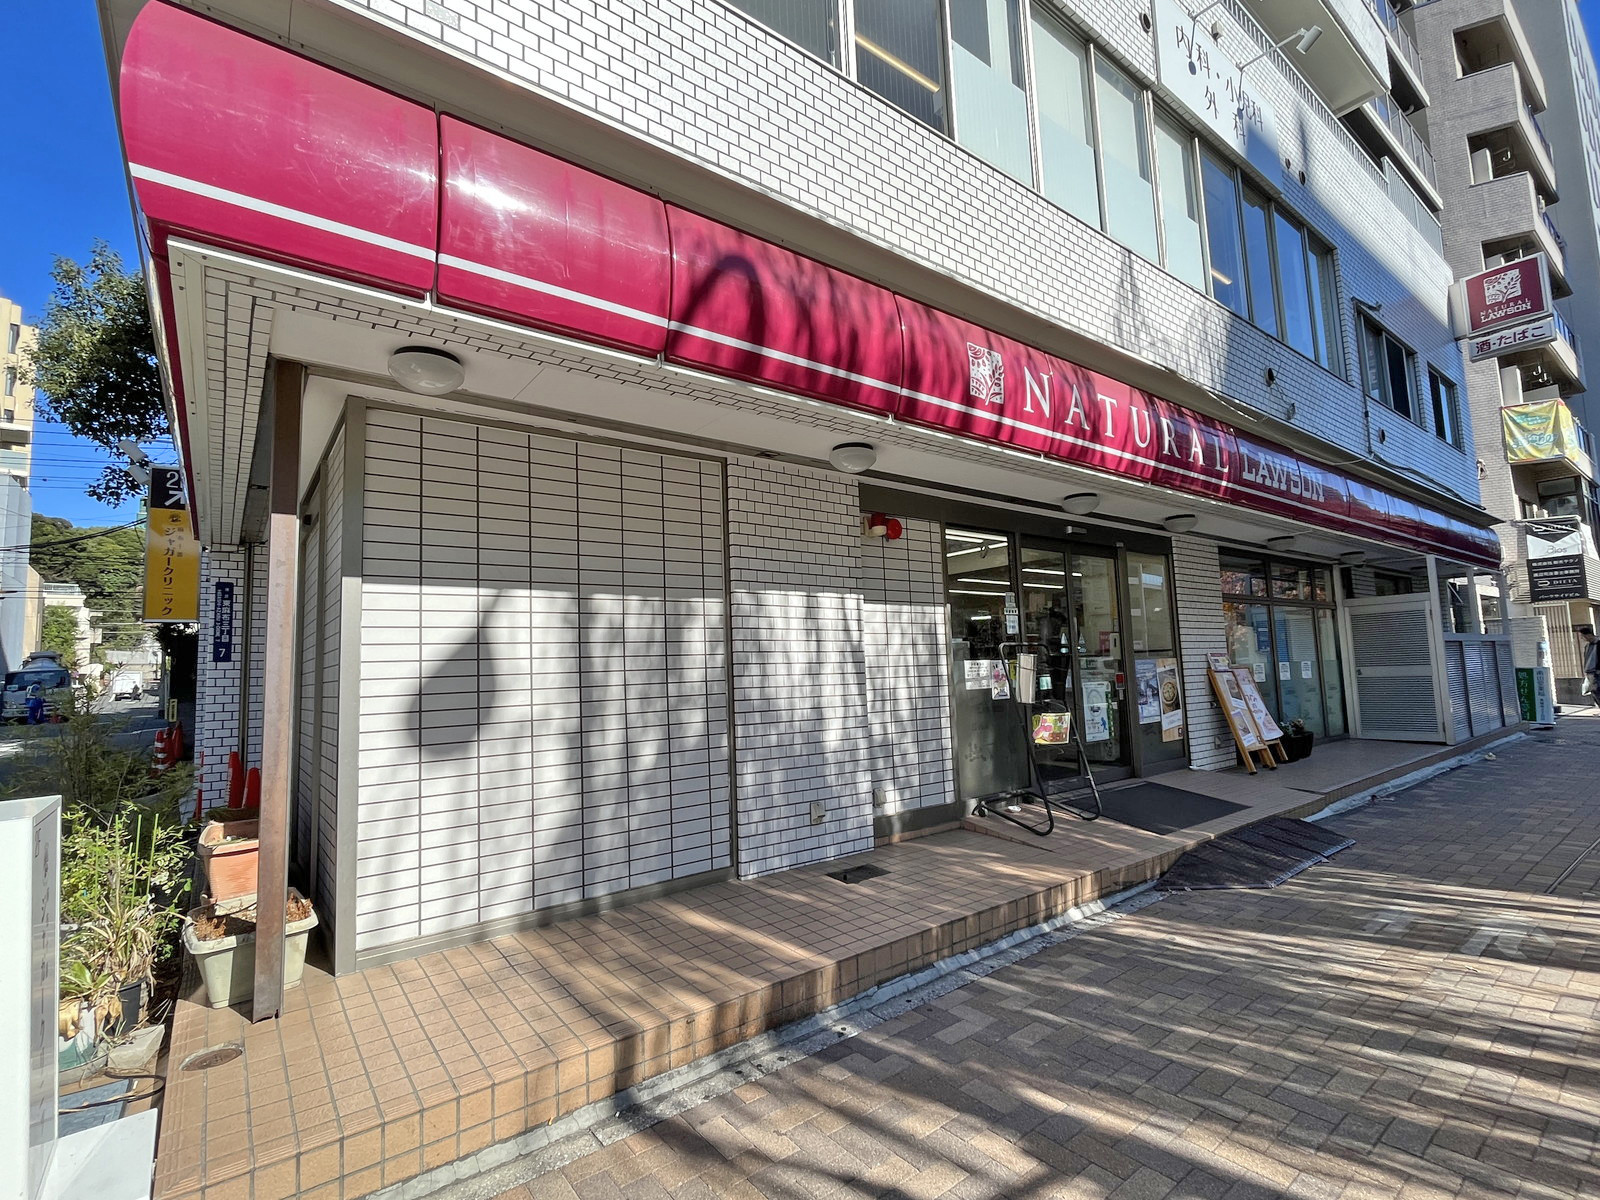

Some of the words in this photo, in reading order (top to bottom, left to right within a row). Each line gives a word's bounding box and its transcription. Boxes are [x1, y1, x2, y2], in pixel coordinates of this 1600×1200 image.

[1480, 298, 1530, 317] NATURAL
[1481, 302, 1532, 323] LAWSON
[1475, 326, 1546, 354] 酒・たばこ
[1023, 365, 1231, 473] NATURAL
[1240, 445, 1325, 503] LAWSON
[161, 527, 176, 616] ジャガークリニック
[218, 648, 226, 658] 7
